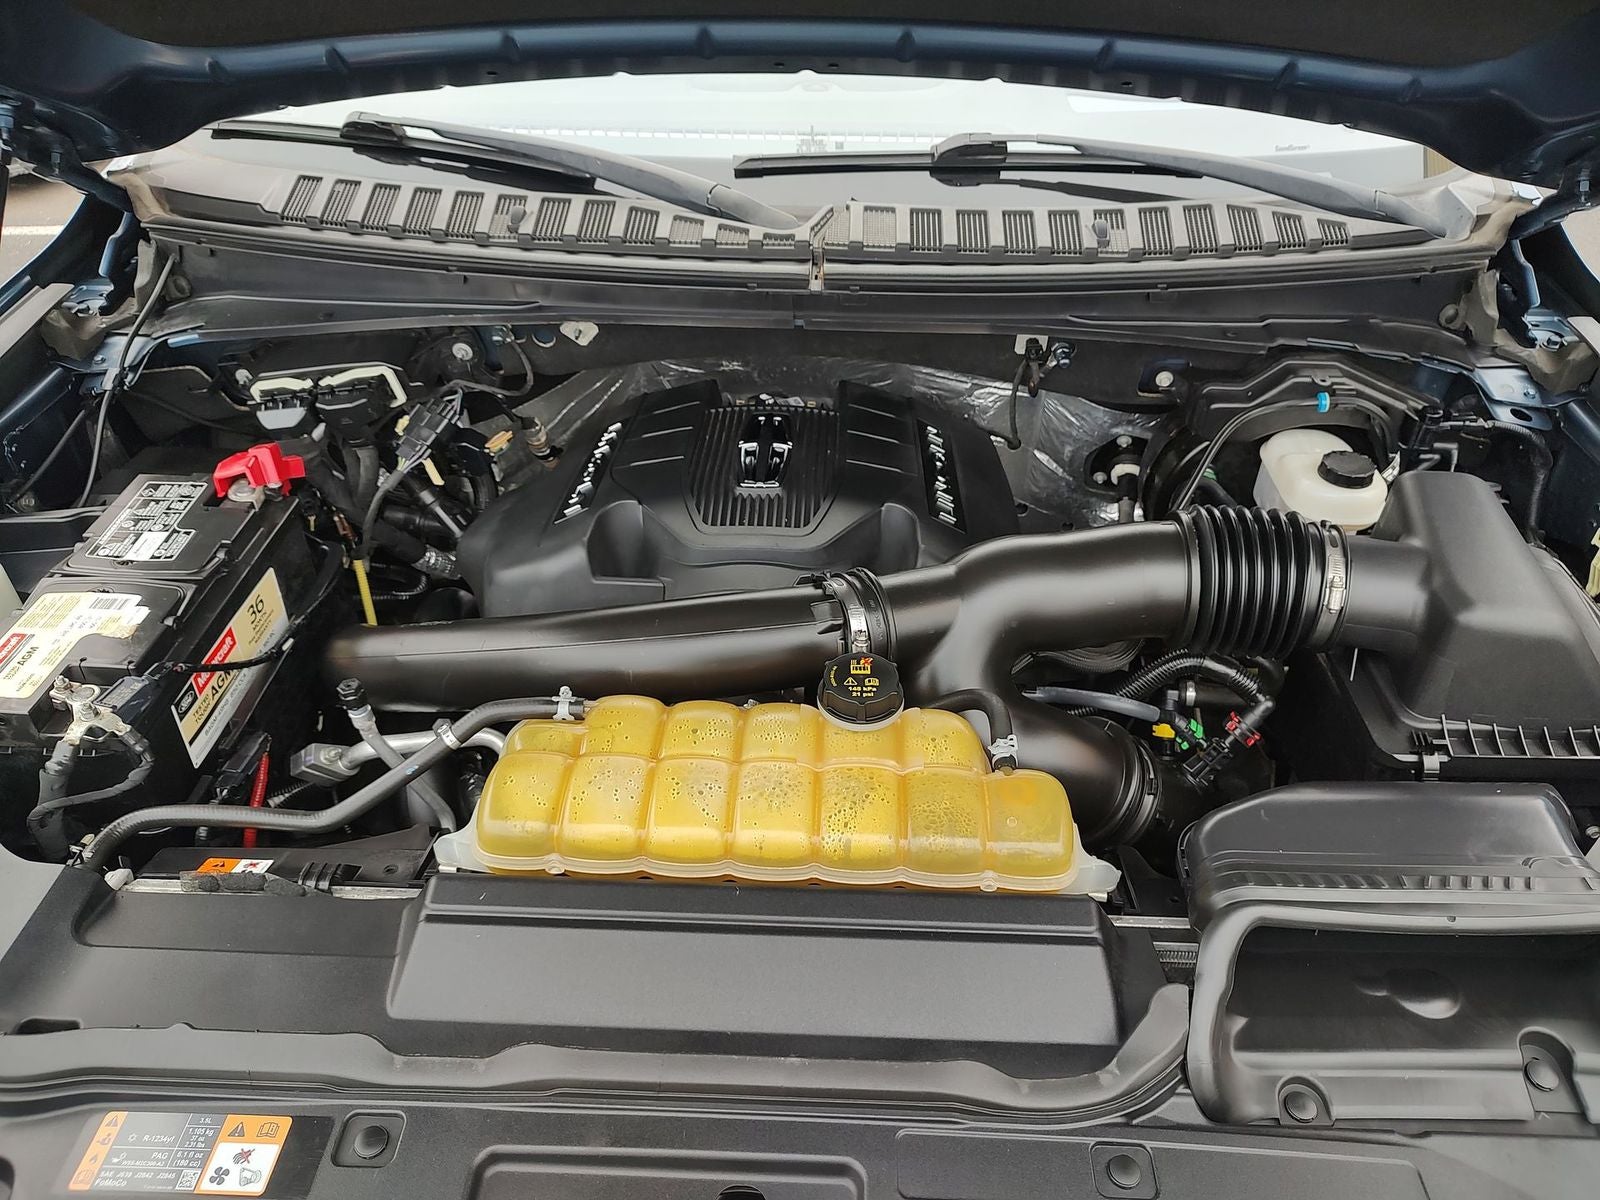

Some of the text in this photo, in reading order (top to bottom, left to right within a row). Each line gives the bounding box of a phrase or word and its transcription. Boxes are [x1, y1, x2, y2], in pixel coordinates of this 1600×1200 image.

[247, 594, 264, 624] 36
[17, 646, 39, 666] AGM
[205, 1128, 215, 1137] kg
[142, 1134, 175, 1144] R-1234yf
[151, 1151, 169, 1160] PAG
[94, 1178, 128, 1187] FoMoCo
